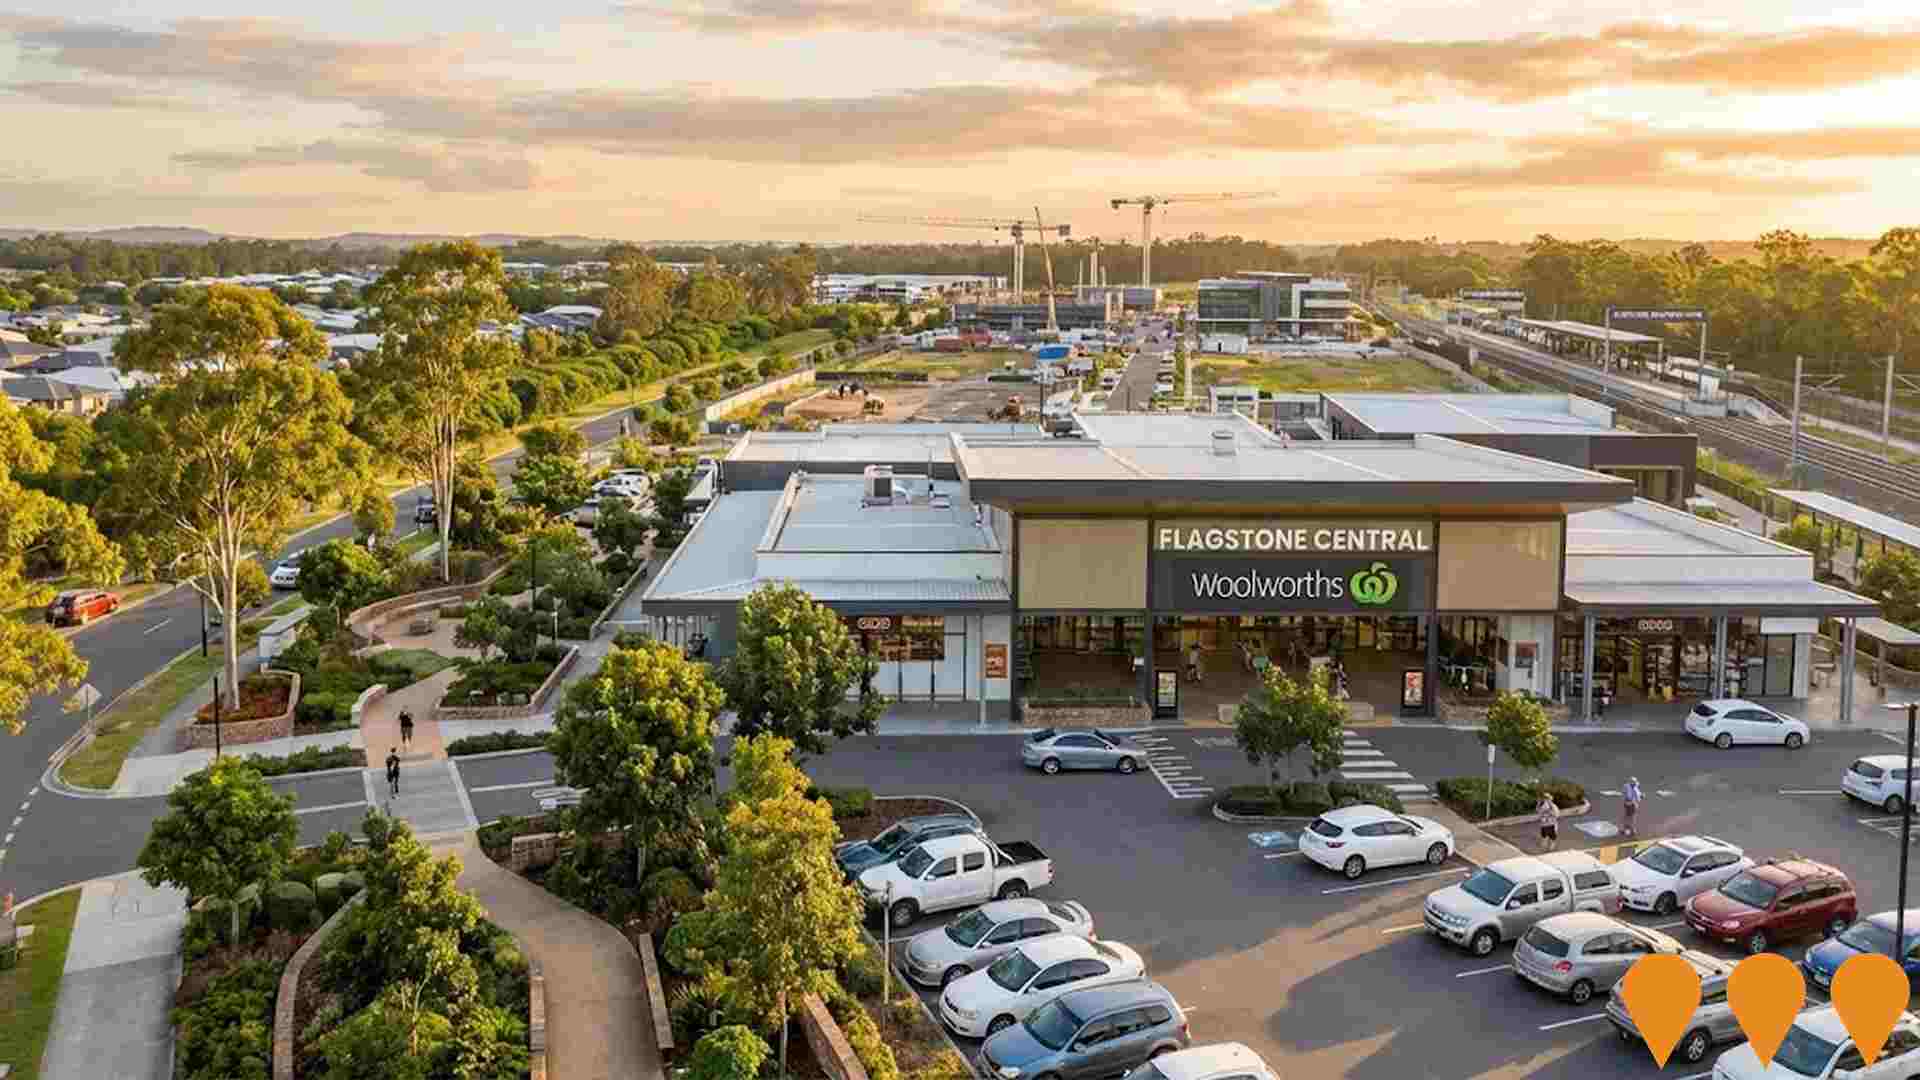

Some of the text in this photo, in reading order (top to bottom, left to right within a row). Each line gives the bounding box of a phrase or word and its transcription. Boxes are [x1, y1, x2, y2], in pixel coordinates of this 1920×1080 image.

[1159, 528, 1430, 551] FLAGSTONE CENTRAL
[1191, 569, 1344, 598] Woolworths
